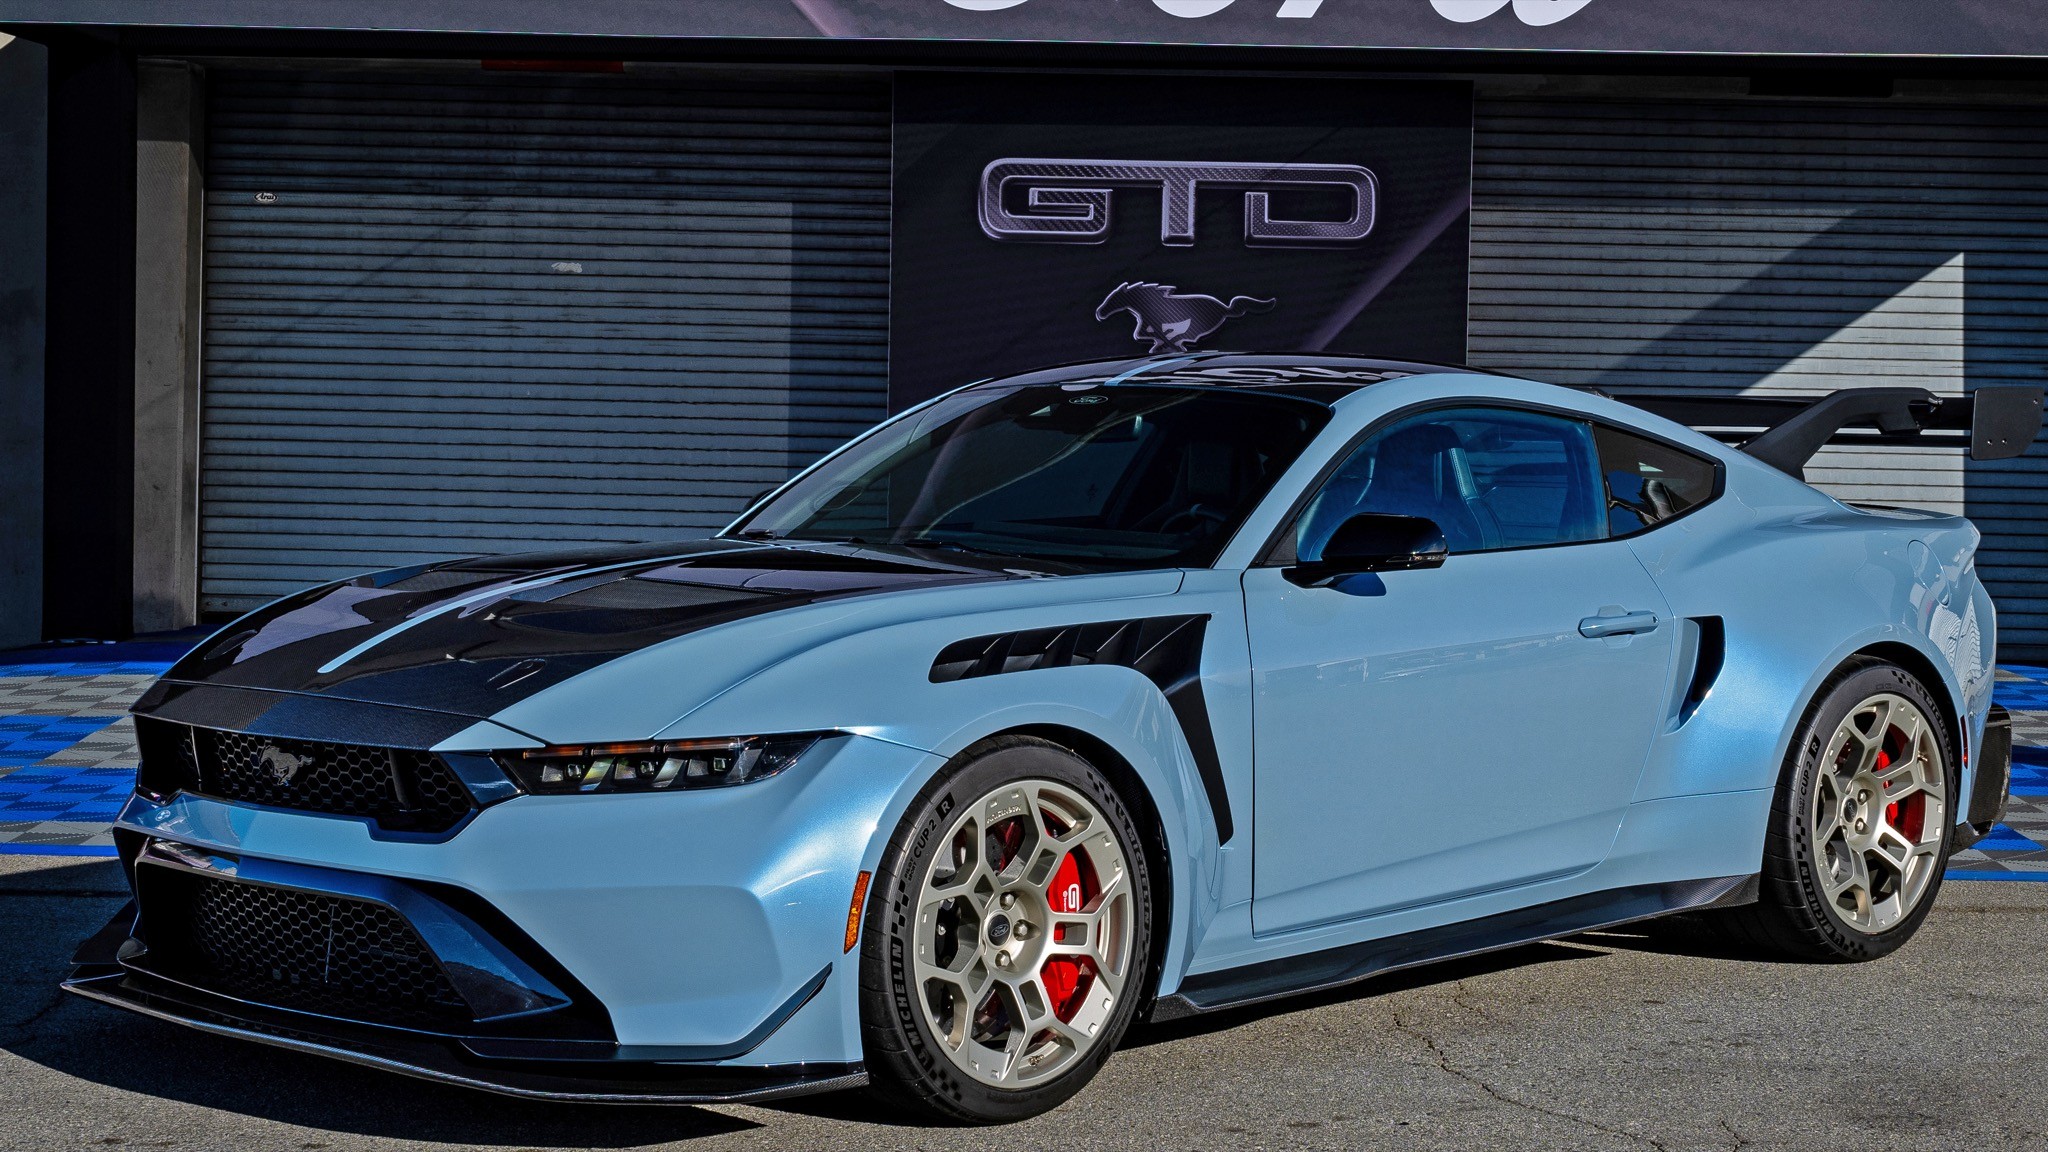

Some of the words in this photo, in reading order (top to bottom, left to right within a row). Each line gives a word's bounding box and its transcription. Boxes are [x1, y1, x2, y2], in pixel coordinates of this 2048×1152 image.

[980, 158, 1379, 248] GTD
[1801, 769, 1810, 796] CUP
[913, 827, 930, 859] CUP
[928, 818, 937, 831] 2
[1801, 865, 1834, 935] MICHELIN
[892, 942, 921, 1047] MICHELIN
